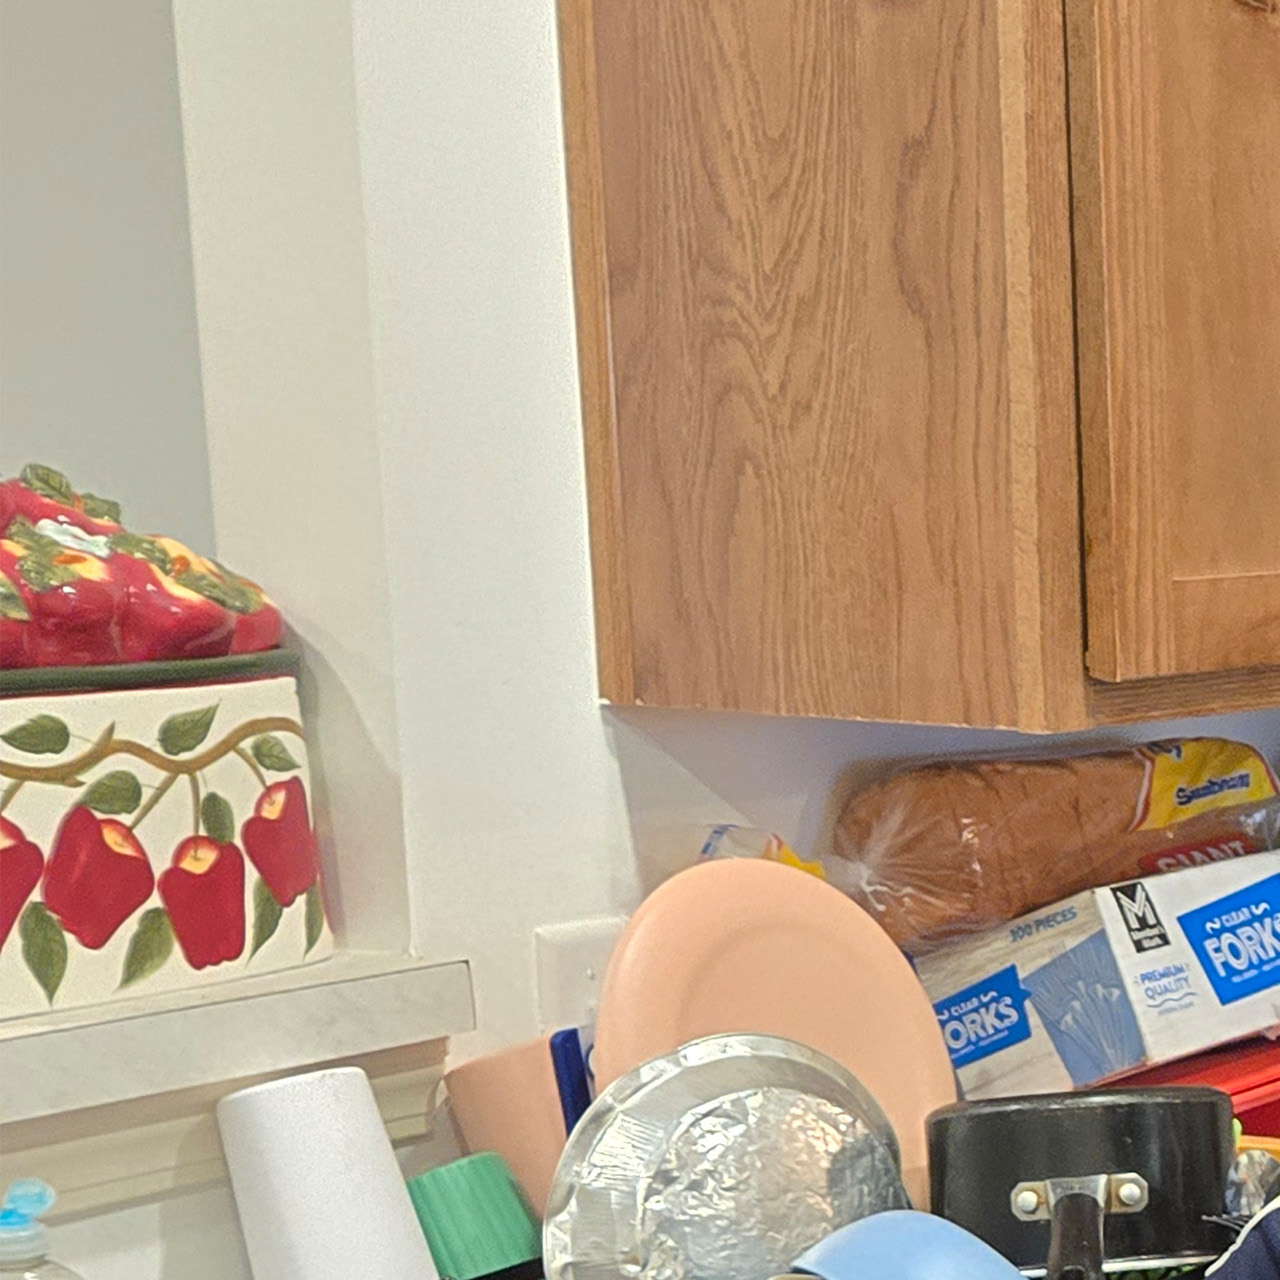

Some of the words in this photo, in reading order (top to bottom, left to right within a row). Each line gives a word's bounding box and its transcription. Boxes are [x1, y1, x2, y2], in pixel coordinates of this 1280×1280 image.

[1034, 906, 1078, 932] PIECES
[1221, 907, 1251, 928] CLEAR
[1139, 965, 1186, 985] PREMIUM
[1144, 976, 1191, 1001] QUALITY
[950, 996, 979, 1016] CLEAR
[944, 996, 1019, 1049] ORKS
